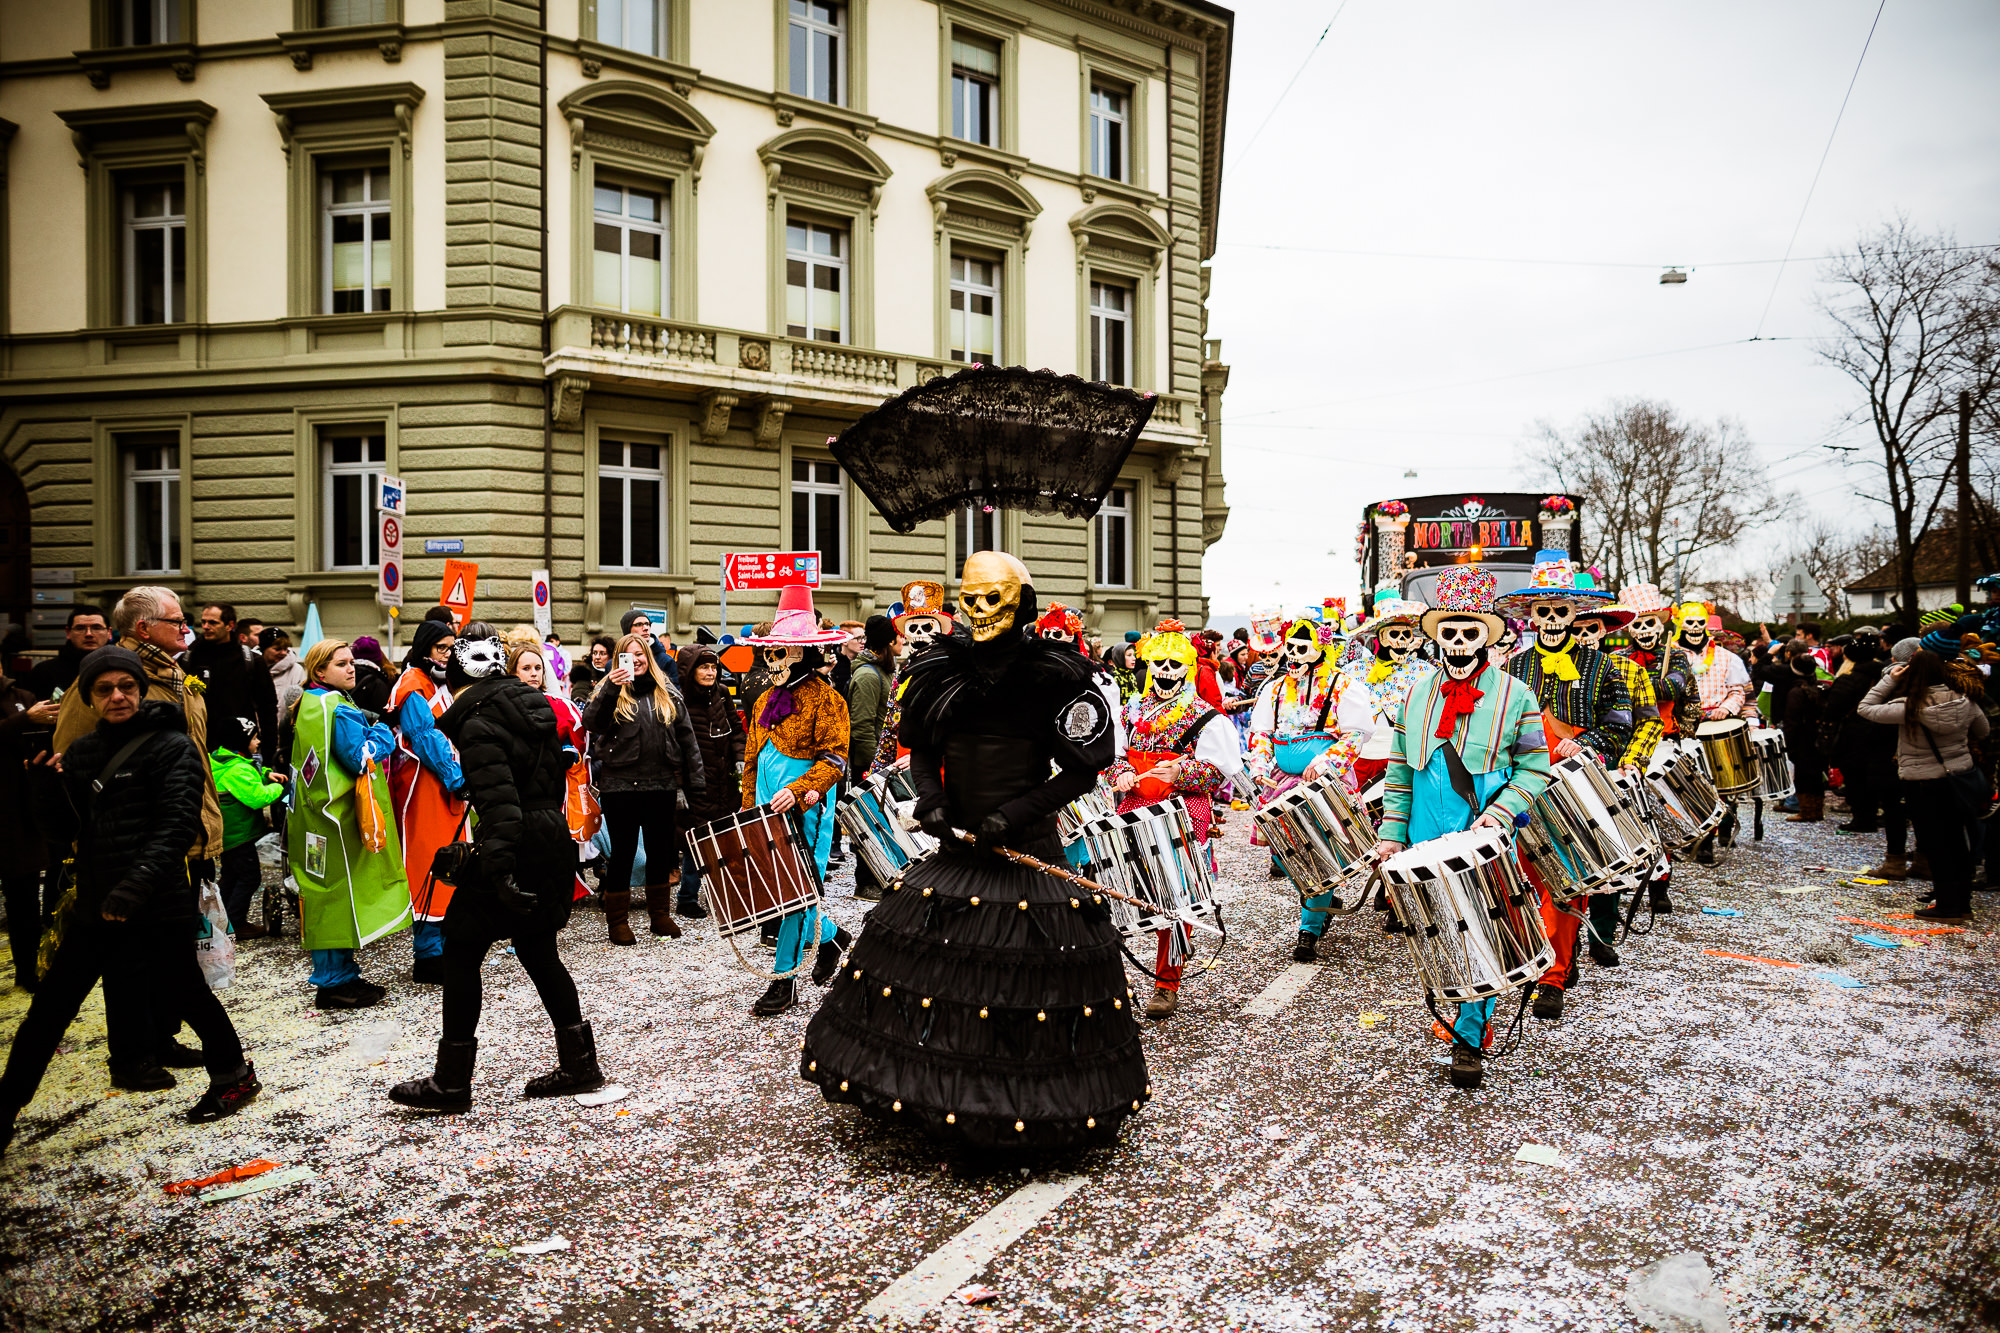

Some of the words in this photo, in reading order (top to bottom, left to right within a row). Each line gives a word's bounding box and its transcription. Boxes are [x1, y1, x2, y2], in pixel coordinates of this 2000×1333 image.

[1413, 522, 1474, 549] MORTA
[1478, 520, 1533, 547] BELLA
[427, 540, 461, 552] Rittergasse
[737, 555, 758, 564] Freiburg
[737, 563, 762, 572] Huningue
[737, 571, 765, 580] Saint-Louis
[737, 580, 749, 590] City
